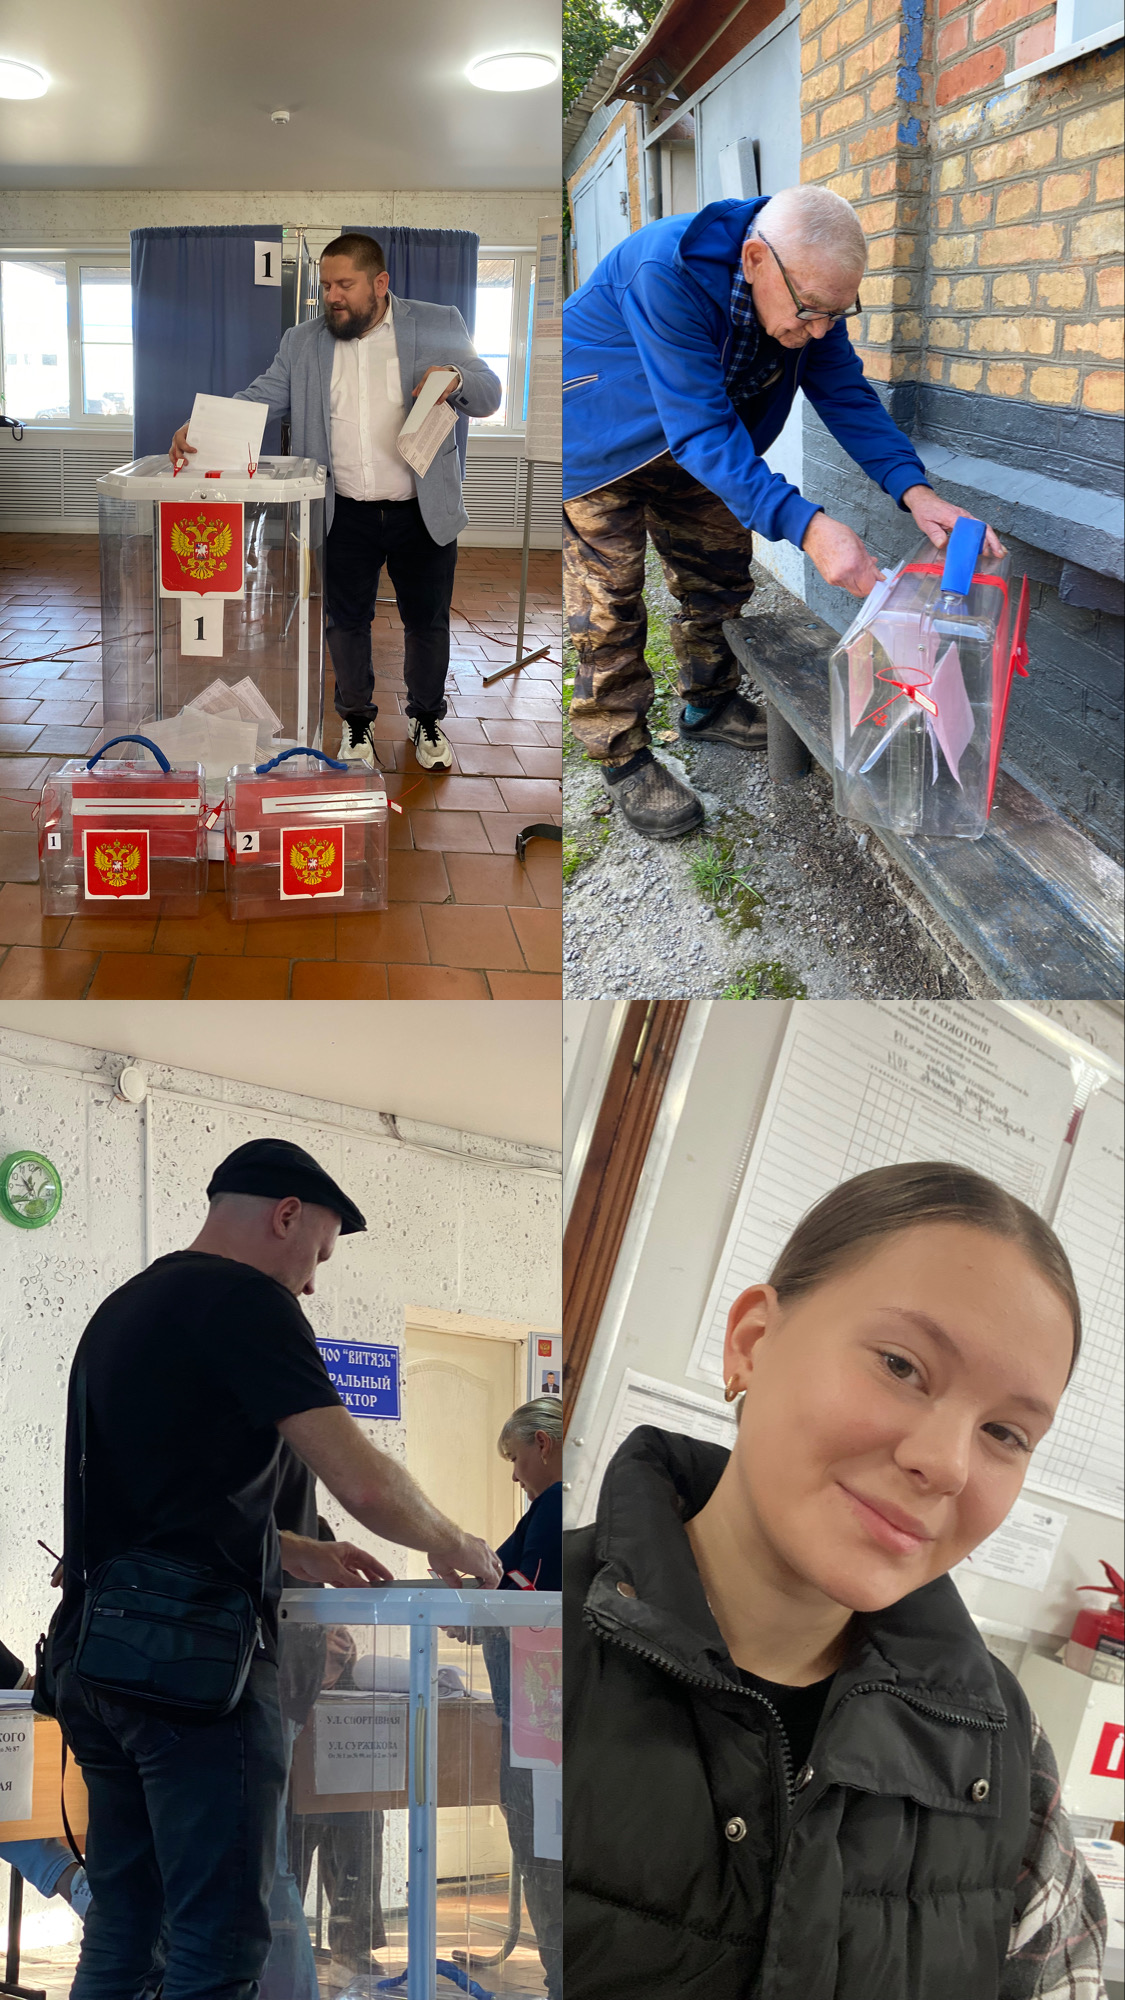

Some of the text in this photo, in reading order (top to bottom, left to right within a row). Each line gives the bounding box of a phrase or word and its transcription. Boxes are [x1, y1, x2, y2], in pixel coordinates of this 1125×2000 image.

[261, 251, 274, 278] 1
[193, 616, 207, 641] 1
[50, 836, 56, 847] 1
[242, 834, 253, 851] 2
[0, 1732, 26, 1742] ОГО
